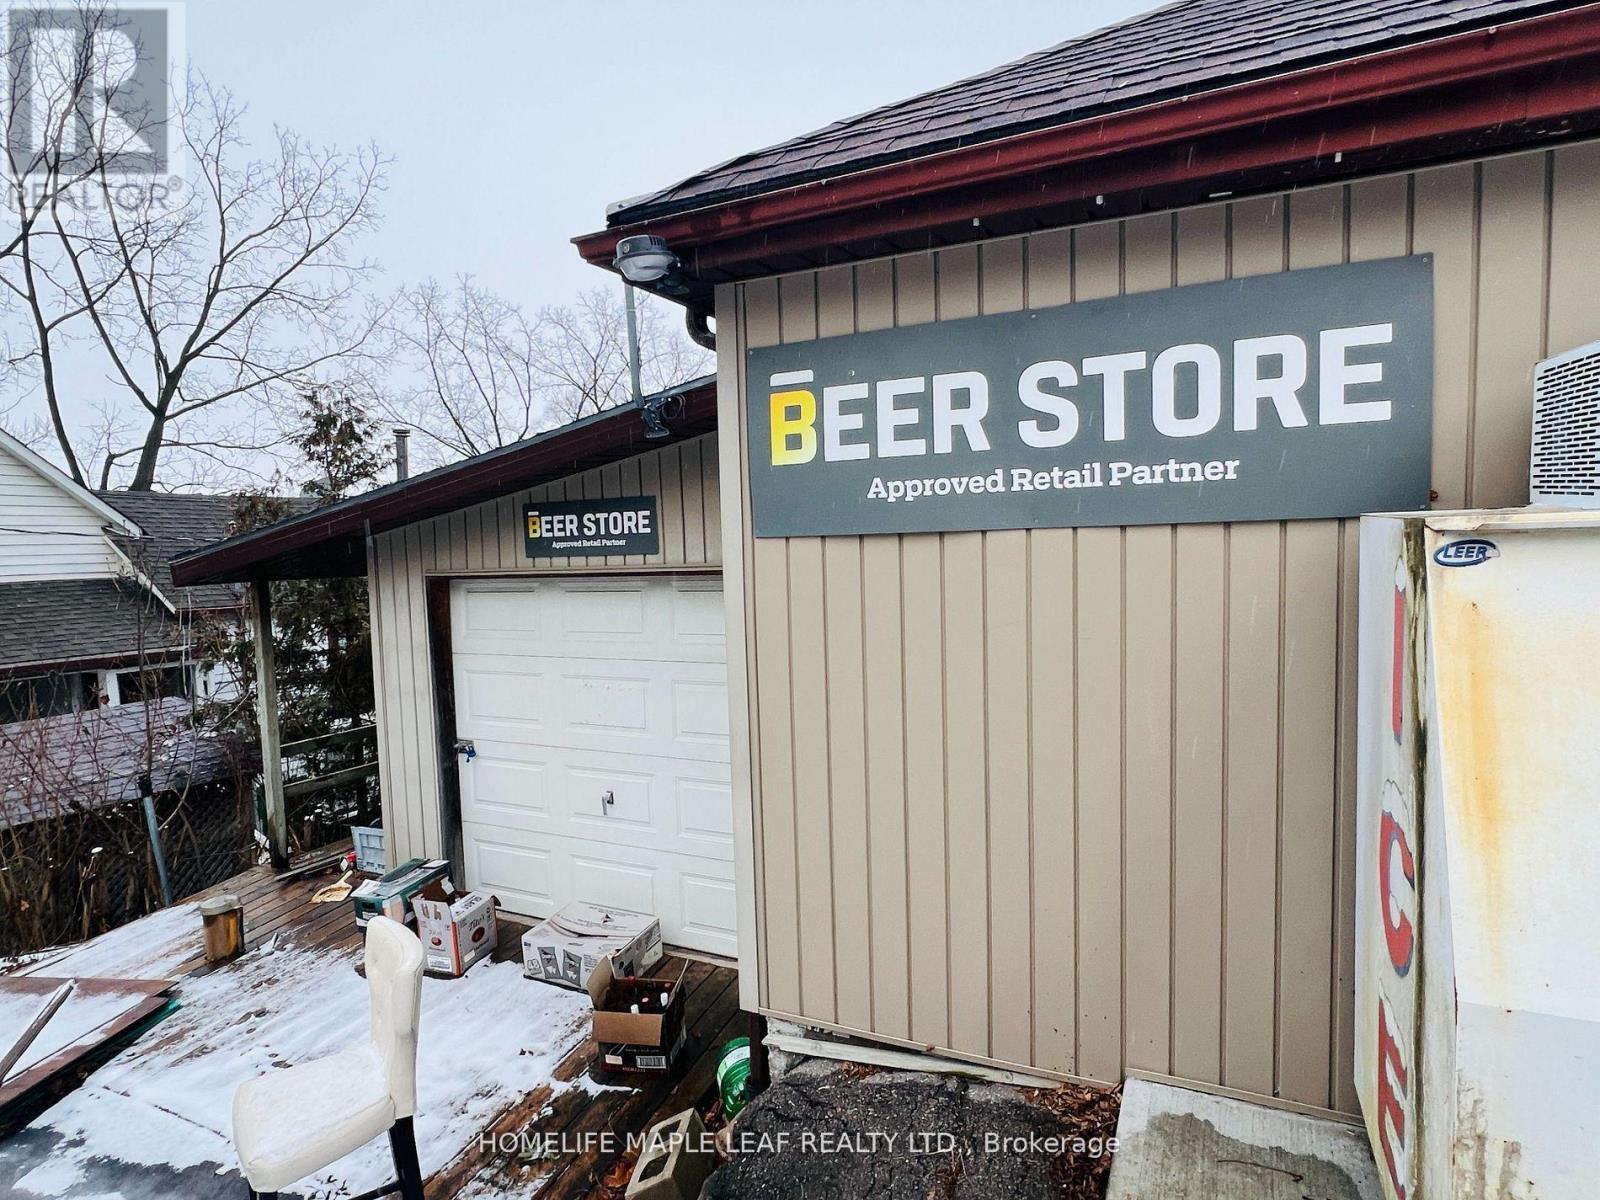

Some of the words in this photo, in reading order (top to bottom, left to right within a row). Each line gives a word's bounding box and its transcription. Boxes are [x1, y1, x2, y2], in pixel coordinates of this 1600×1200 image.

[769, 370, 991, 467] BEER
[1016, 323, 1393, 449] STORE
[867, 469, 1006, 502] Approved
[1010, 462, 1103, 492] Retail
[1108, 458, 1240, 486] Partner
[527, 511, 579, 538] BEER
[582, 510, 651, 535] STORE
[552, 541, 582, 549] Approved
[582, 539, 602, 547] Retail
[1442, 544, 1488, 559] LEER
